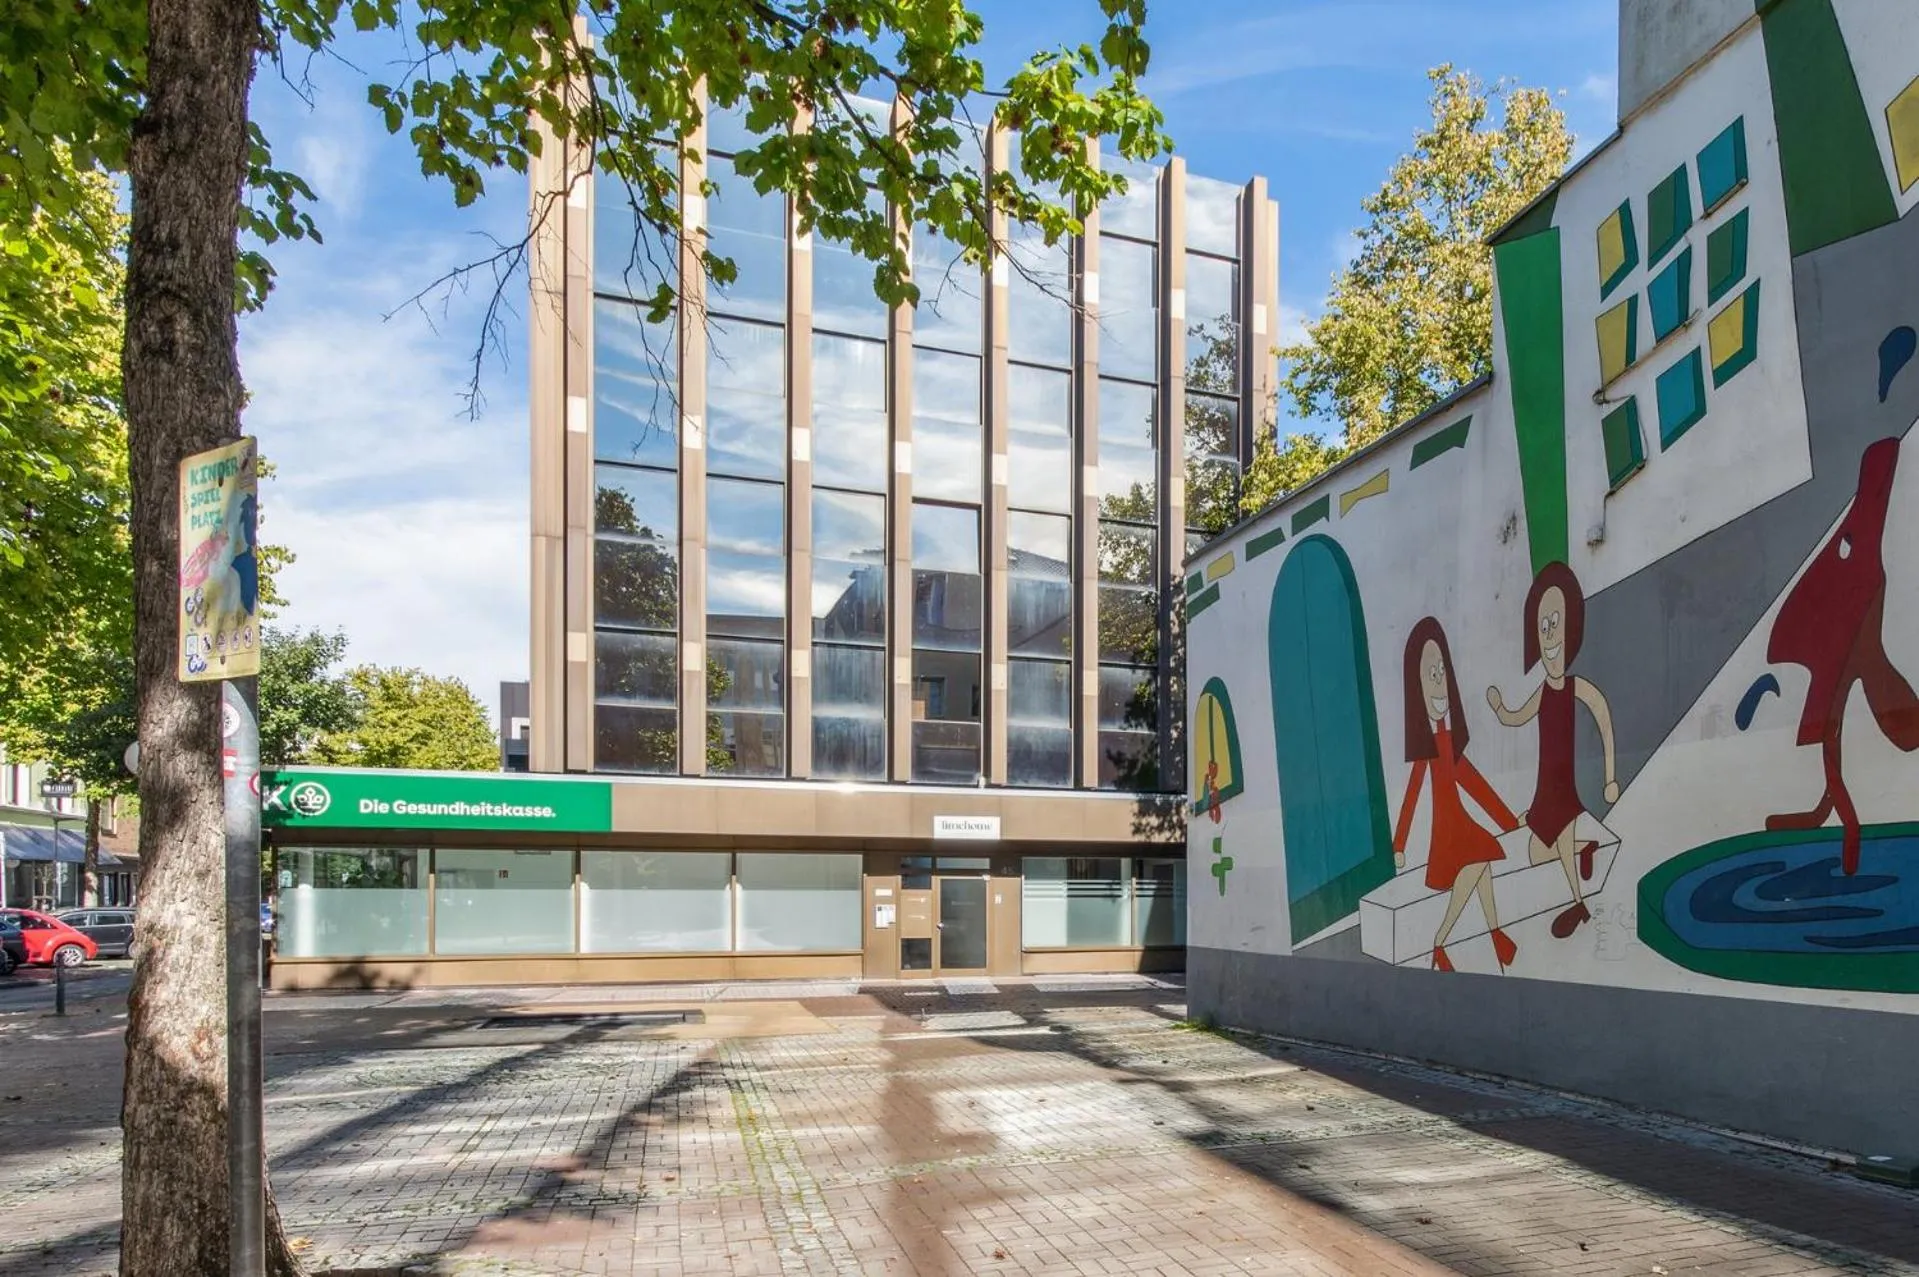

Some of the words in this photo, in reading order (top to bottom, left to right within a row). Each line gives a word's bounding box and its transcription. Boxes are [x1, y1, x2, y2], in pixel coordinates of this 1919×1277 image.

[190, 457, 238, 486] KINDER
[190, 488, 222, 508] SPIEL
[191, 510, 223, 531] PLATZ
[359, 798, 390, 814] Die
[393, 799, 556, 818] Gesundheitskasse.
